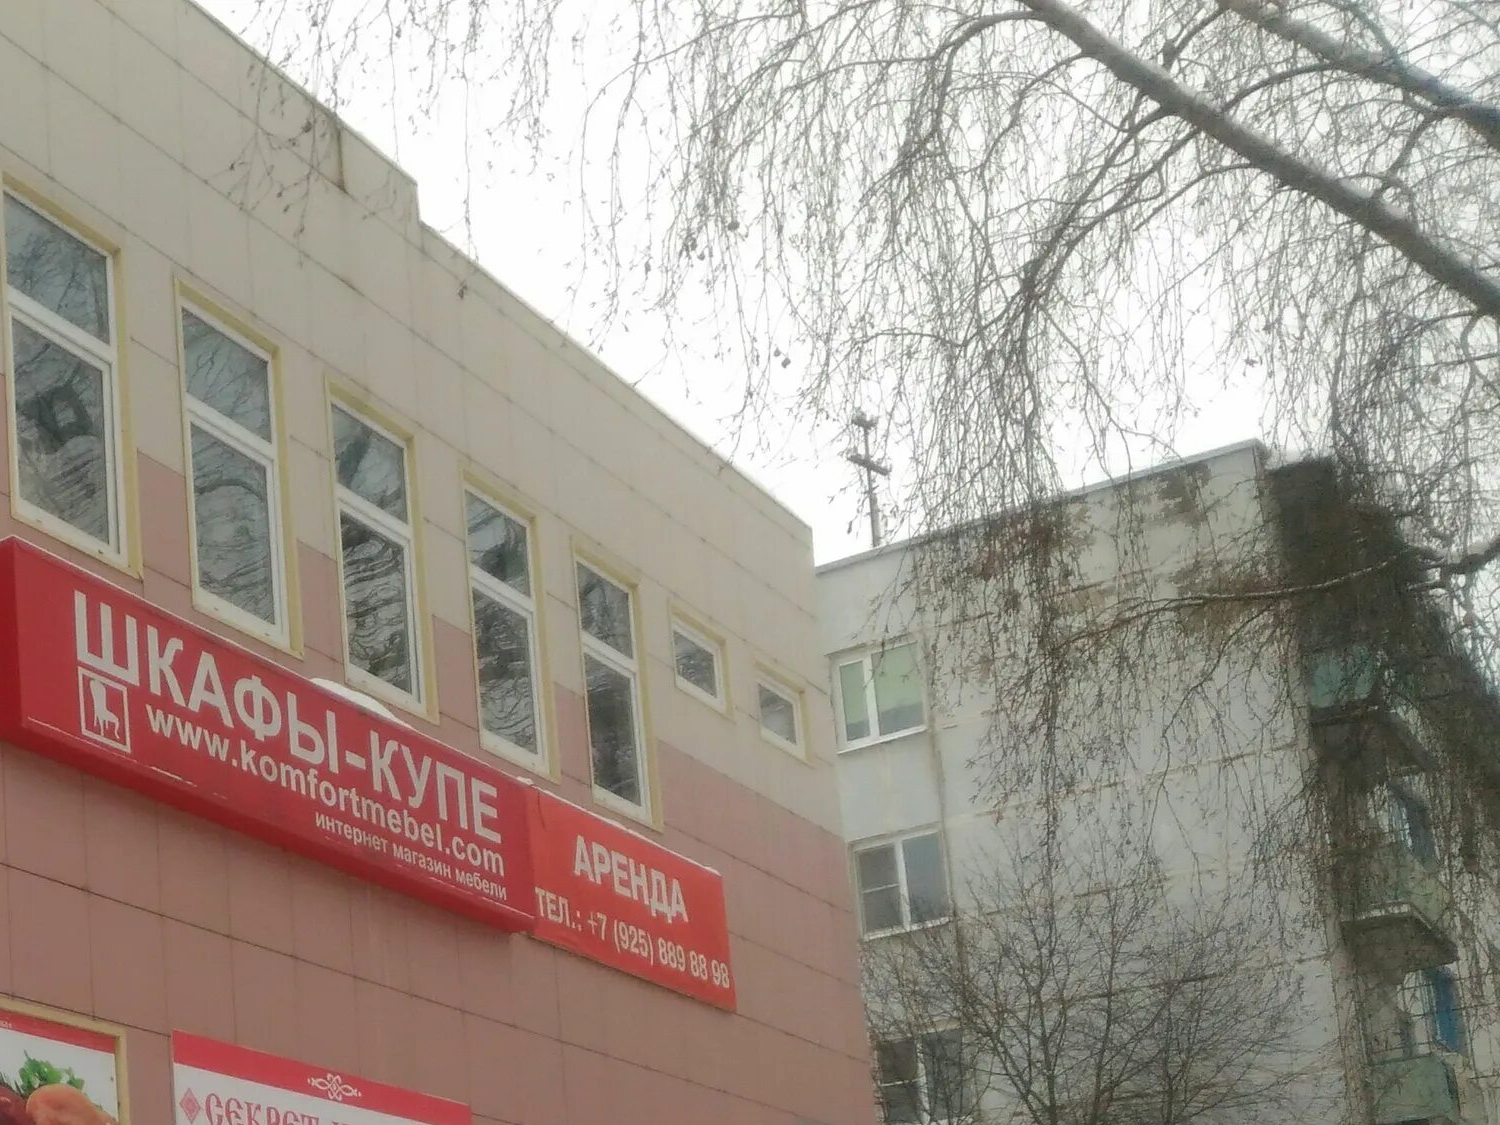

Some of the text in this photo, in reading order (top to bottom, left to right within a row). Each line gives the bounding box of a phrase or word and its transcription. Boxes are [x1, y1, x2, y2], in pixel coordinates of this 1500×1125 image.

[74, 590, 502, 843] ШКАФЫ-КУПЕ
[145, 704, 504, 876] www.komfortmebel.com
[315, 811, 507, 900] интернет магазин мебели
[574, 835, 688, 923] АРЕНДА
[588, 911, 607, 940] +7
[614, 919, 653, 966] (925)
[658, 937, 685, 972] 889
[689, 951, 708, 980] 88
[711, 960, 730, 988] 98
